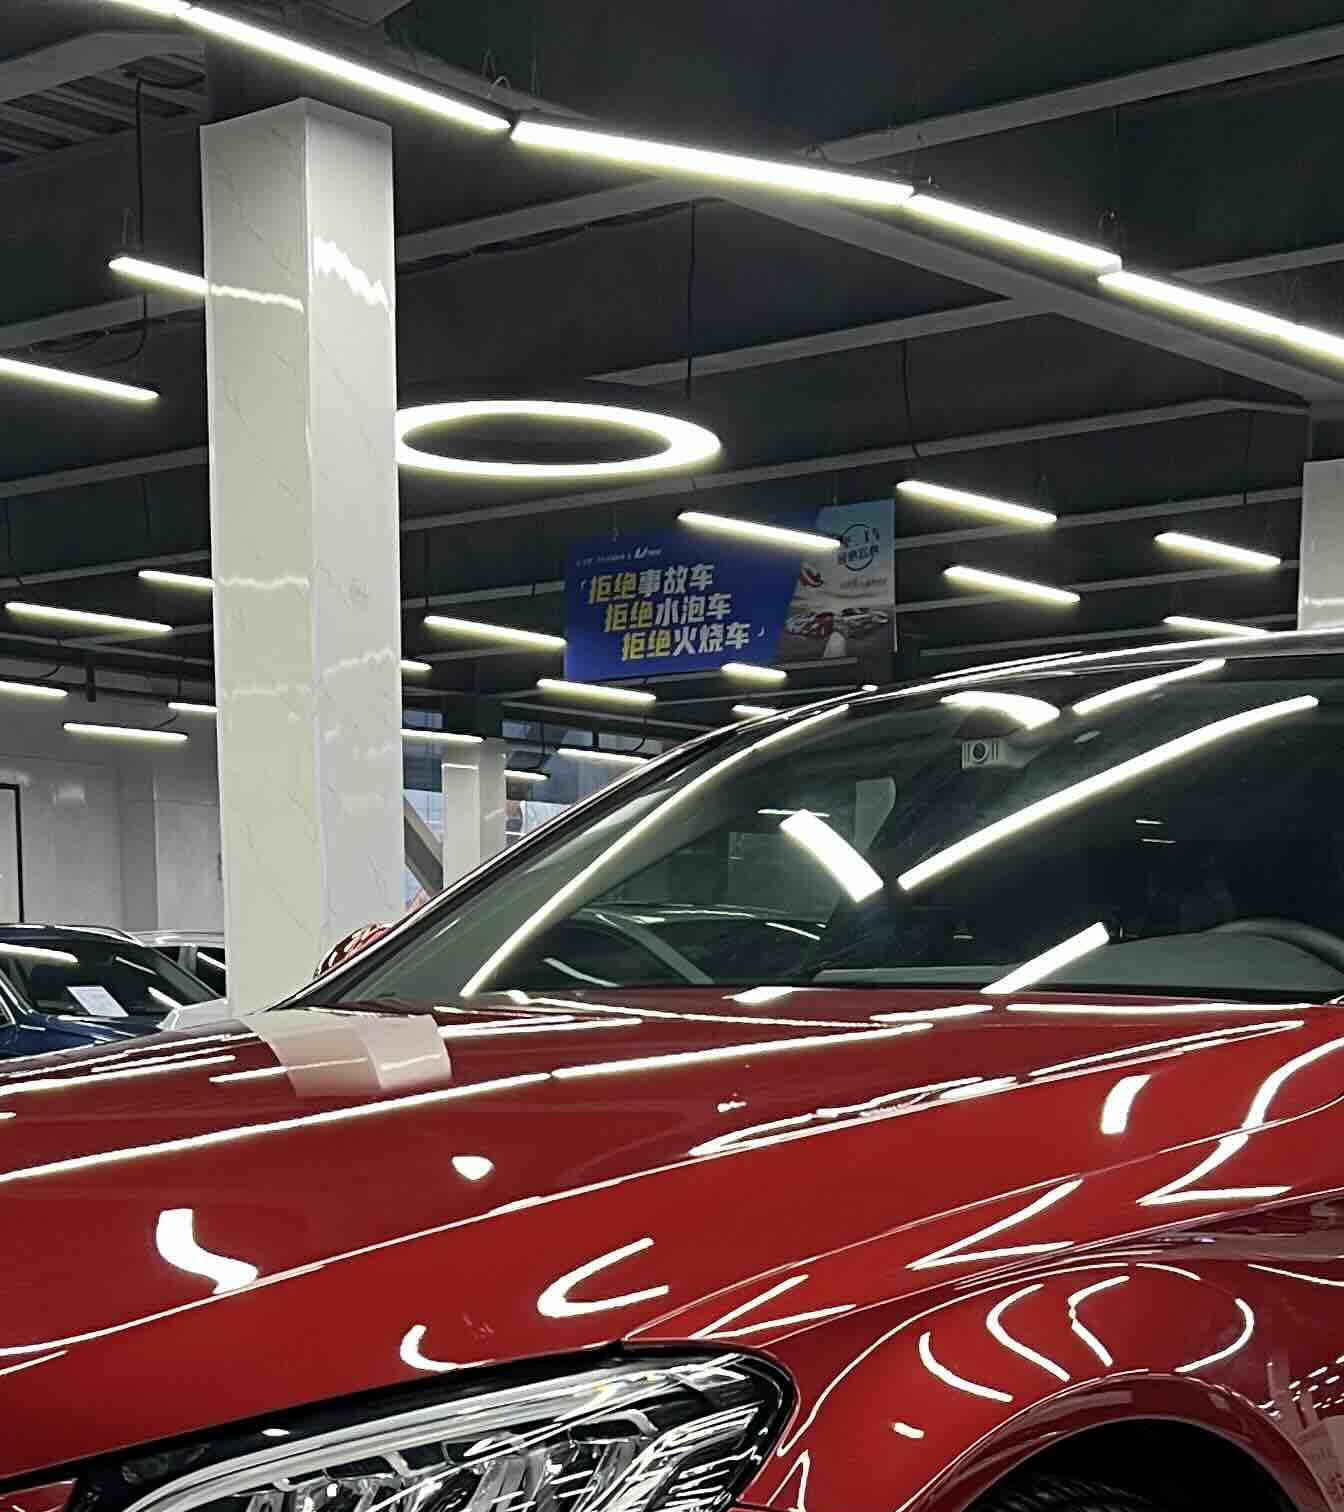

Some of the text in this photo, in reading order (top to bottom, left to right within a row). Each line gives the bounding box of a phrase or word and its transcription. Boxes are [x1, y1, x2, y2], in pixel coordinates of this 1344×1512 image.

[604, 593, 733, 633] 拒绝水泡车
